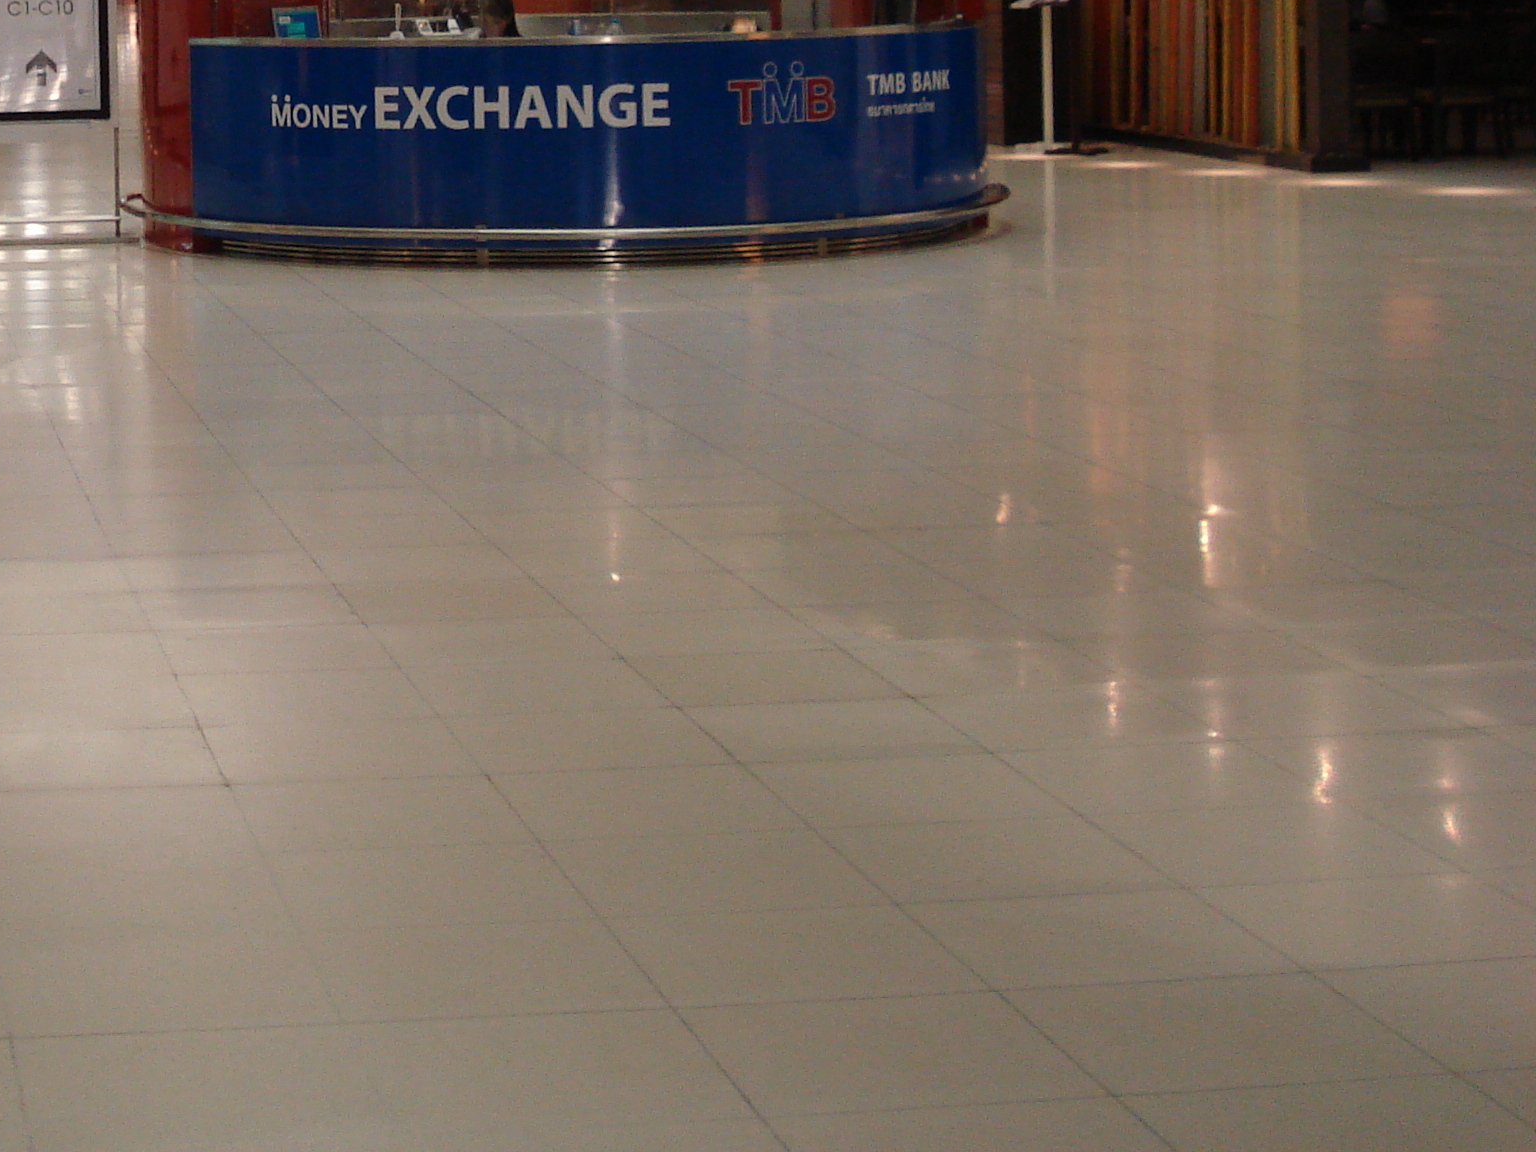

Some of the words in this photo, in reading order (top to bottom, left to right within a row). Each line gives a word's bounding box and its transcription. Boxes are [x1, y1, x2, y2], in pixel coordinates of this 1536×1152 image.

[7, 0, 74, 17] C1-C10
[727, 61, 837, 126] TMB
[867, 71, 906, 96] TMB
[911, 69, 951, 93] BANK
[270, 94, 368, 130] MONEY
[373, 82, 671, 130] EXCHANGE
